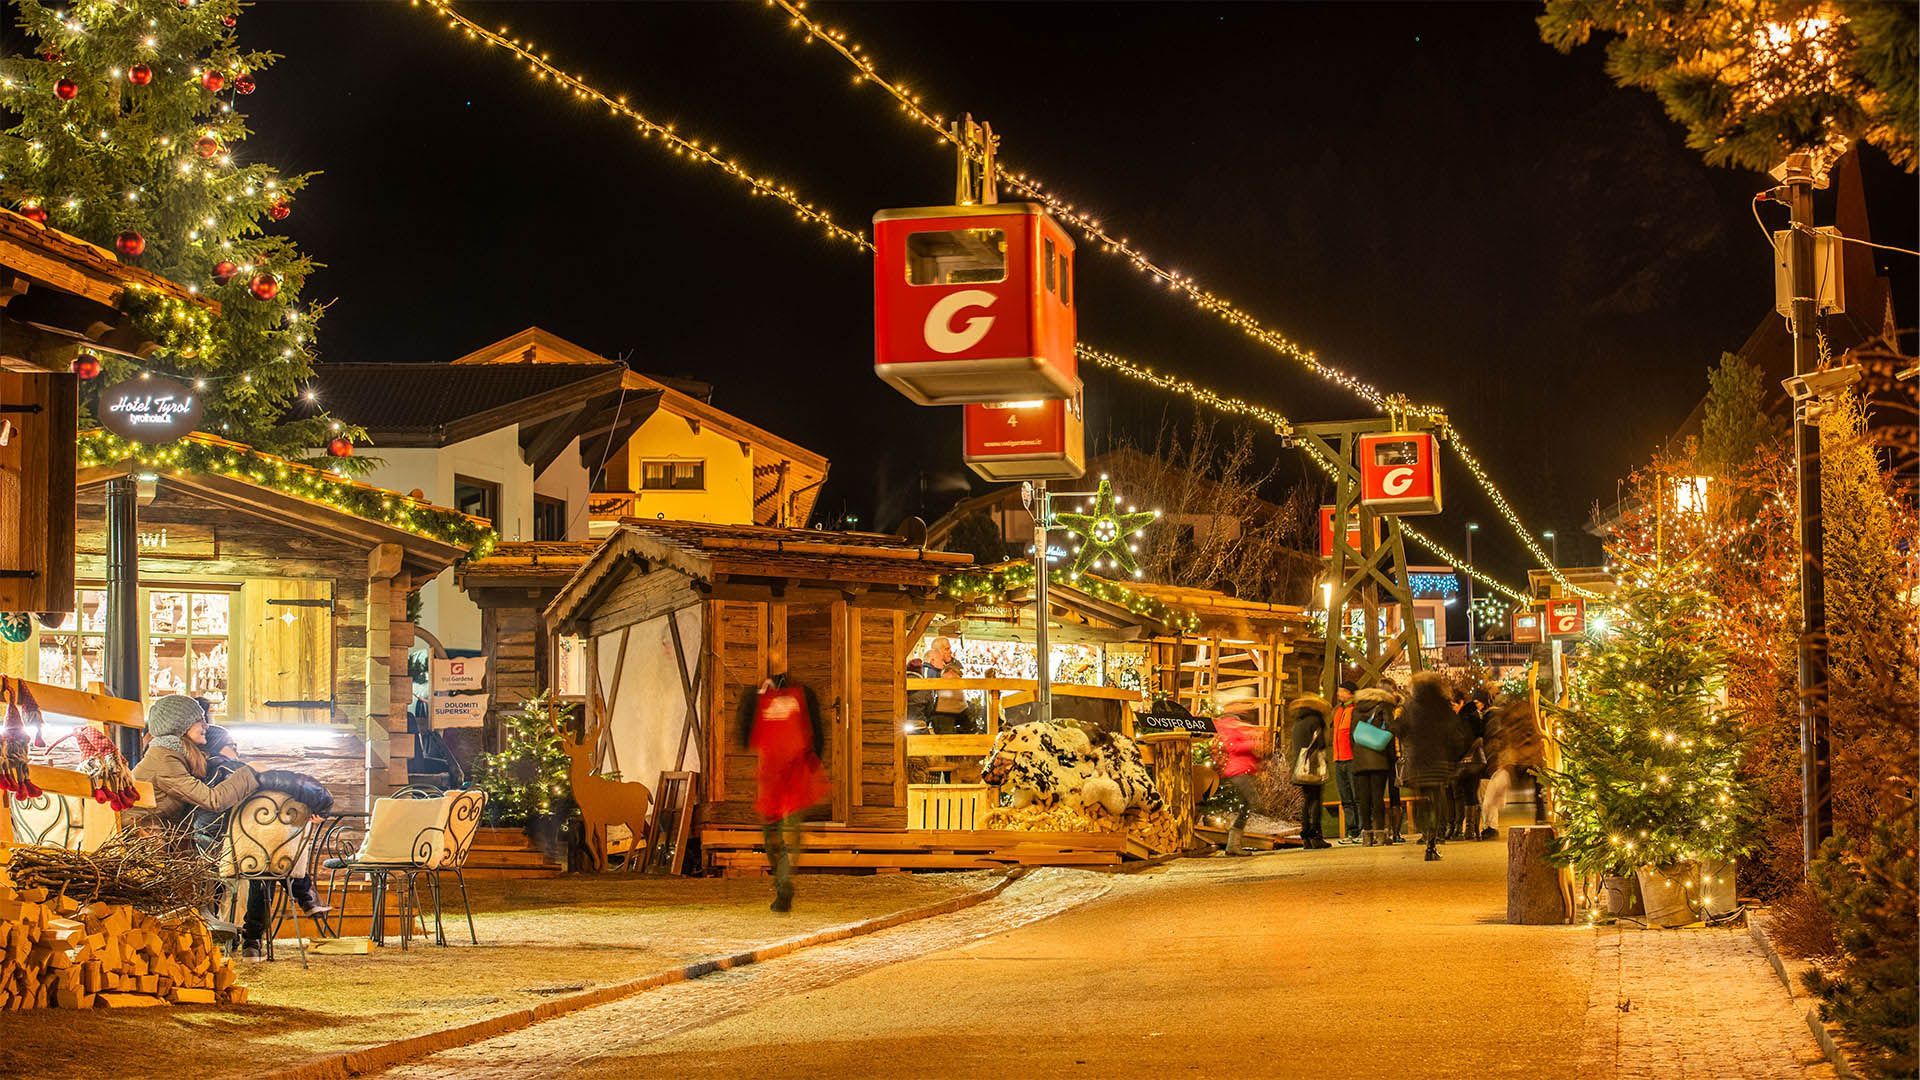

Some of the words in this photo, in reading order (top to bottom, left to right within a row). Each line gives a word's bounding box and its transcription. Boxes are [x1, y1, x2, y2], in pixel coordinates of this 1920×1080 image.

[924, 289, 998, 354] G
[110, 395, 151, 412] Hotel
[154, 395, 192, 414] Tyrol
[1007, 414, 1019, 427] 4
[1383, 467, 1414, 496] G
[1558, 616, 1575, 632] G
[1146, 716, 1184, 729] OYSTER
[1184, 719, 1206, 730] BAR
